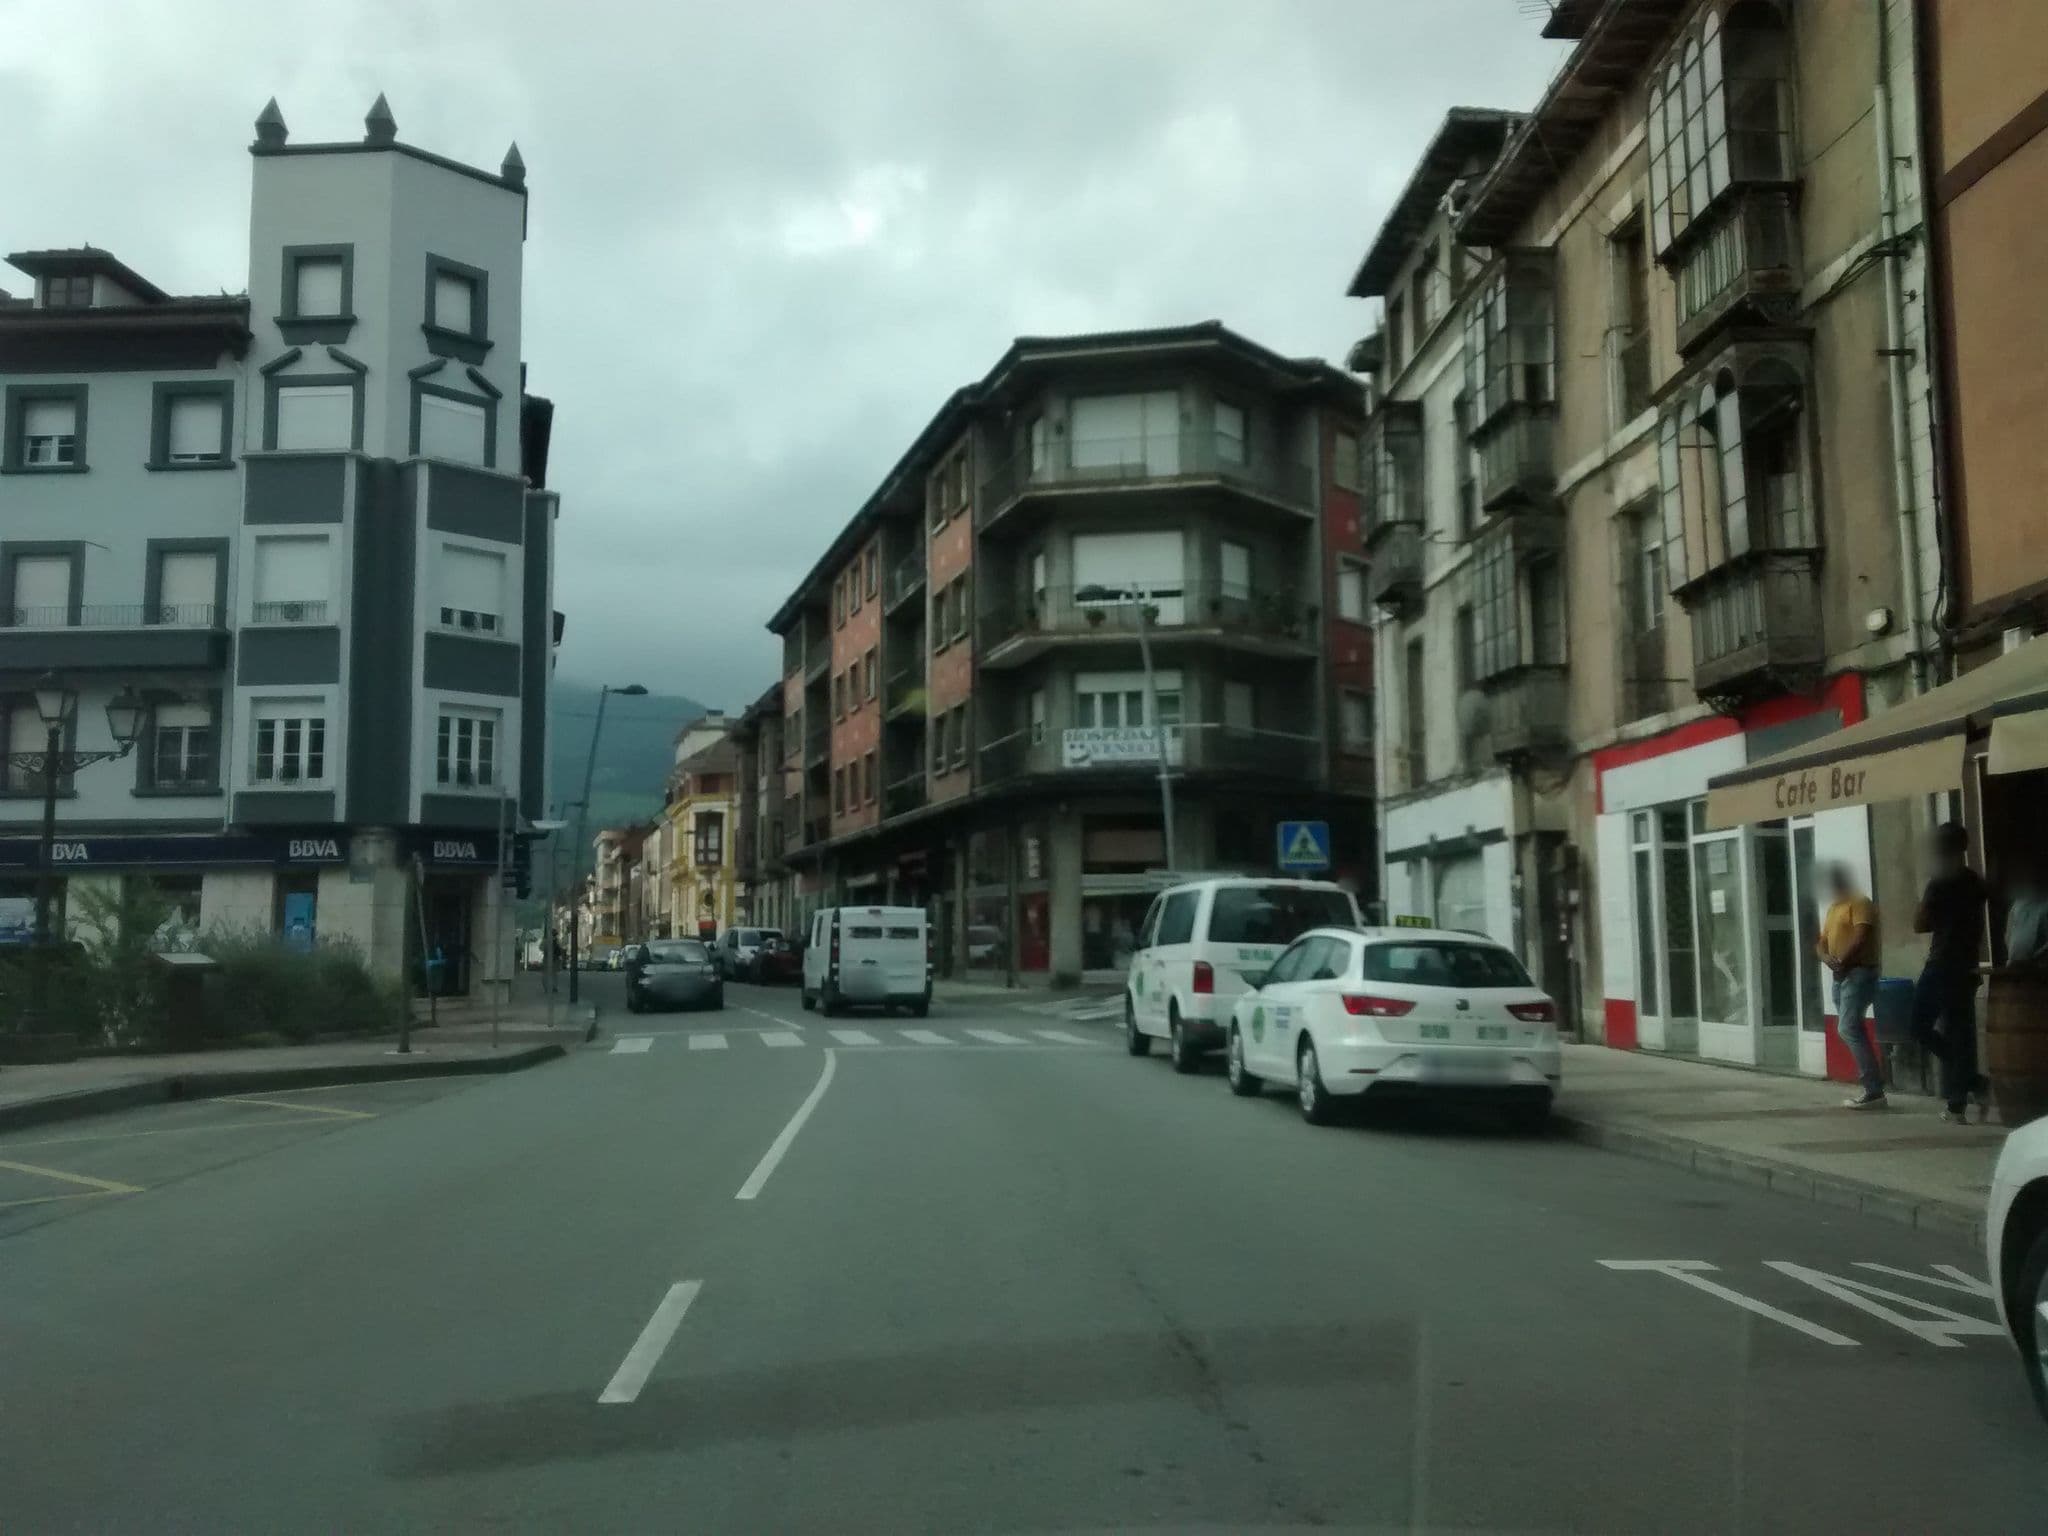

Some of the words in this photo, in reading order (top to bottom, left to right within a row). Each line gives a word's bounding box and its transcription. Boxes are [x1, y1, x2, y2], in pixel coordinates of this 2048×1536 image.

[1830, 766, 1866, 800] Bar
[51, 843, 89, 860] BVA
[288, 839, 339, 858] BBVA
[433, 840, 477, 859] BBVA
